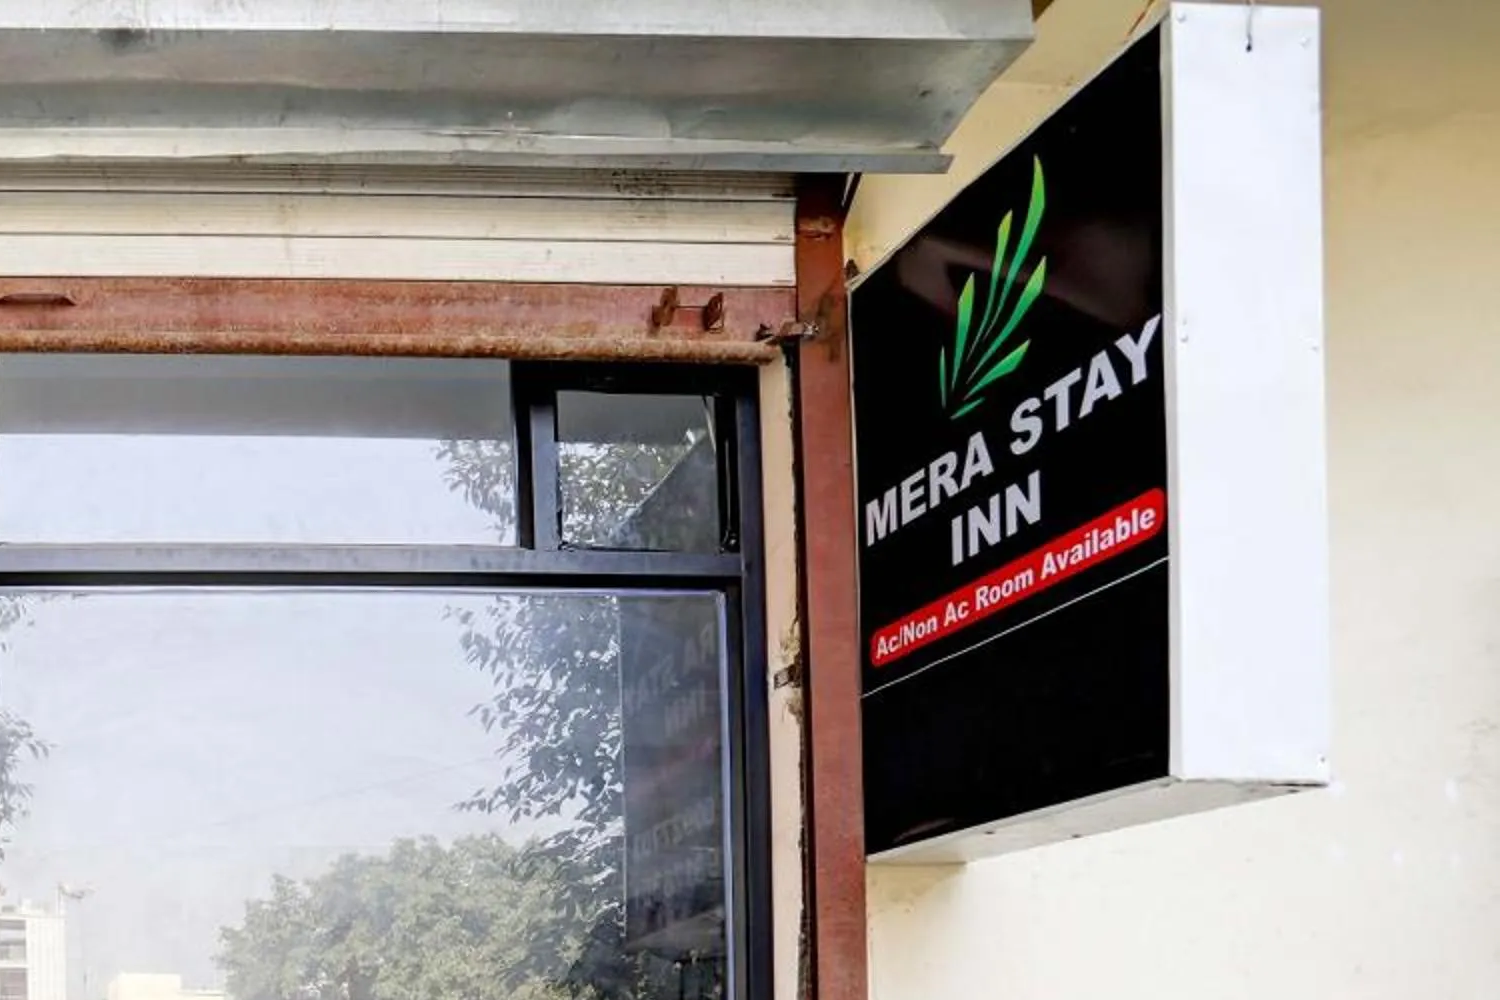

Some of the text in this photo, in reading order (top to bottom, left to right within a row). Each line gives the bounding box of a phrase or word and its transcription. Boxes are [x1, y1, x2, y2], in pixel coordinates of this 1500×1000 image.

[865, 313, 1162, 547] MERA STAY
[875, 507, 1156, 659] Ac/Non Ac Room Available
[950, 469, 1042, 567] INN
